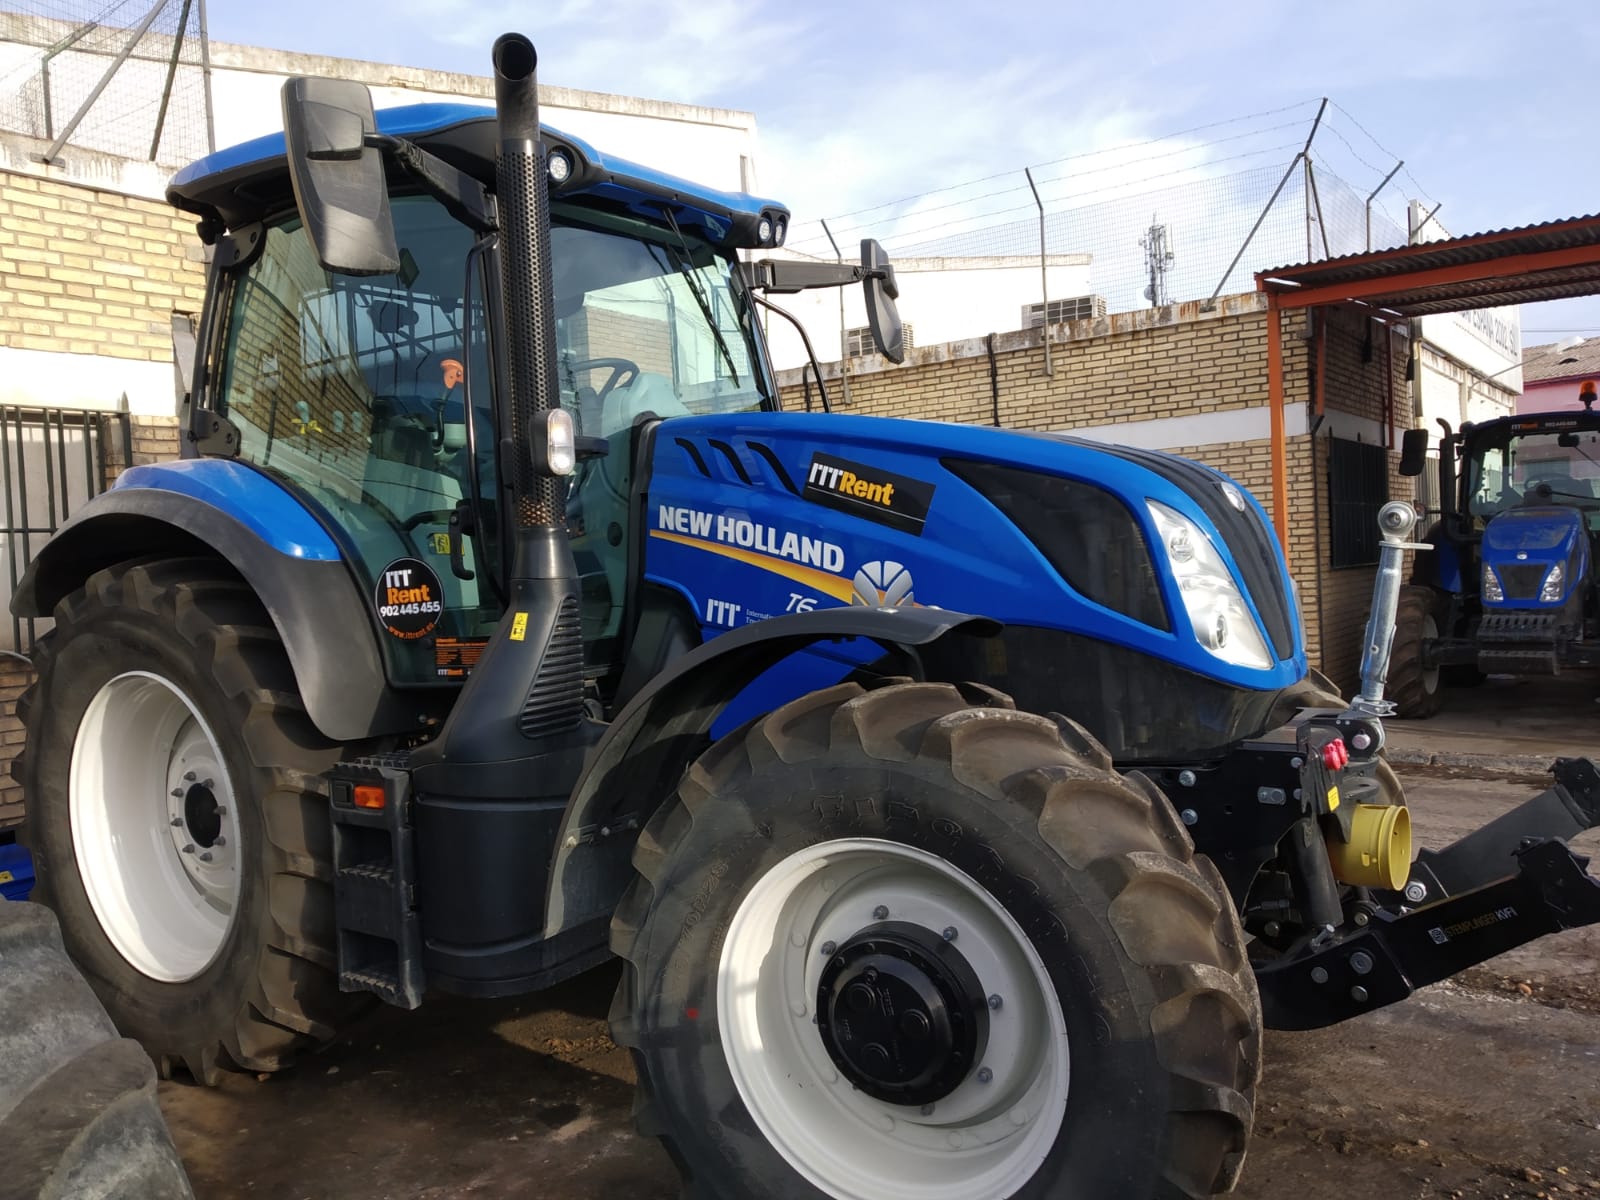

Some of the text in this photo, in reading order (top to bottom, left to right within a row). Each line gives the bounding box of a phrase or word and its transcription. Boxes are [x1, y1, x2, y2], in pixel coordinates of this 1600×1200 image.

[659, 505, 845, 573] NEW HOLLAND
[385, 569, 412, 588] ITT
[386, 584, 431, 605] Rent
[380, 601, 440, 617] 902 445 455
[705, 598, 741, 627] ITT
